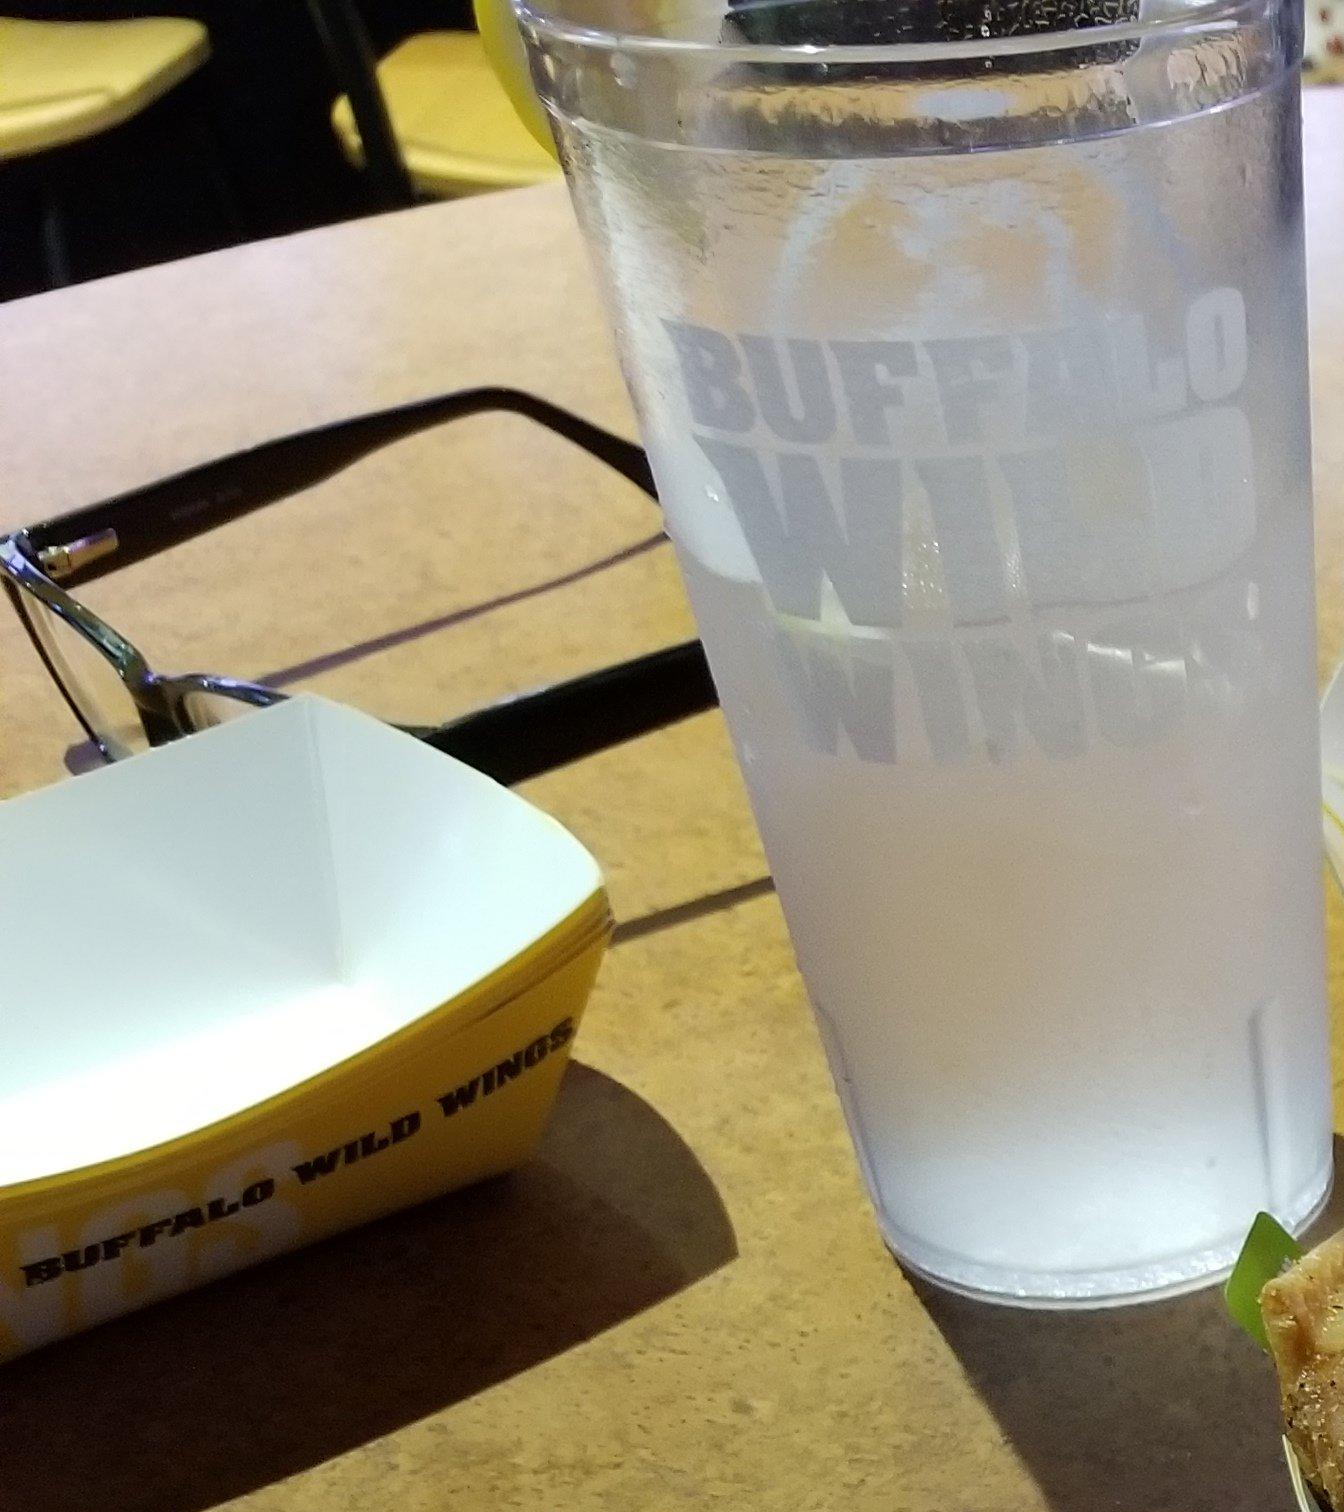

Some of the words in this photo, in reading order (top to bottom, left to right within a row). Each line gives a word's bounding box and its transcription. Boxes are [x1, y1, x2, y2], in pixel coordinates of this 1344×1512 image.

[660, 286, 1247, 445] BUFFALO
[693, 404, 1257, 631] WILD
[20, 1178, 275, 1287] BUFFALO
[291, 1110, 421, 1185] WILD
[436, 1016, 573, 1118] WINGS
